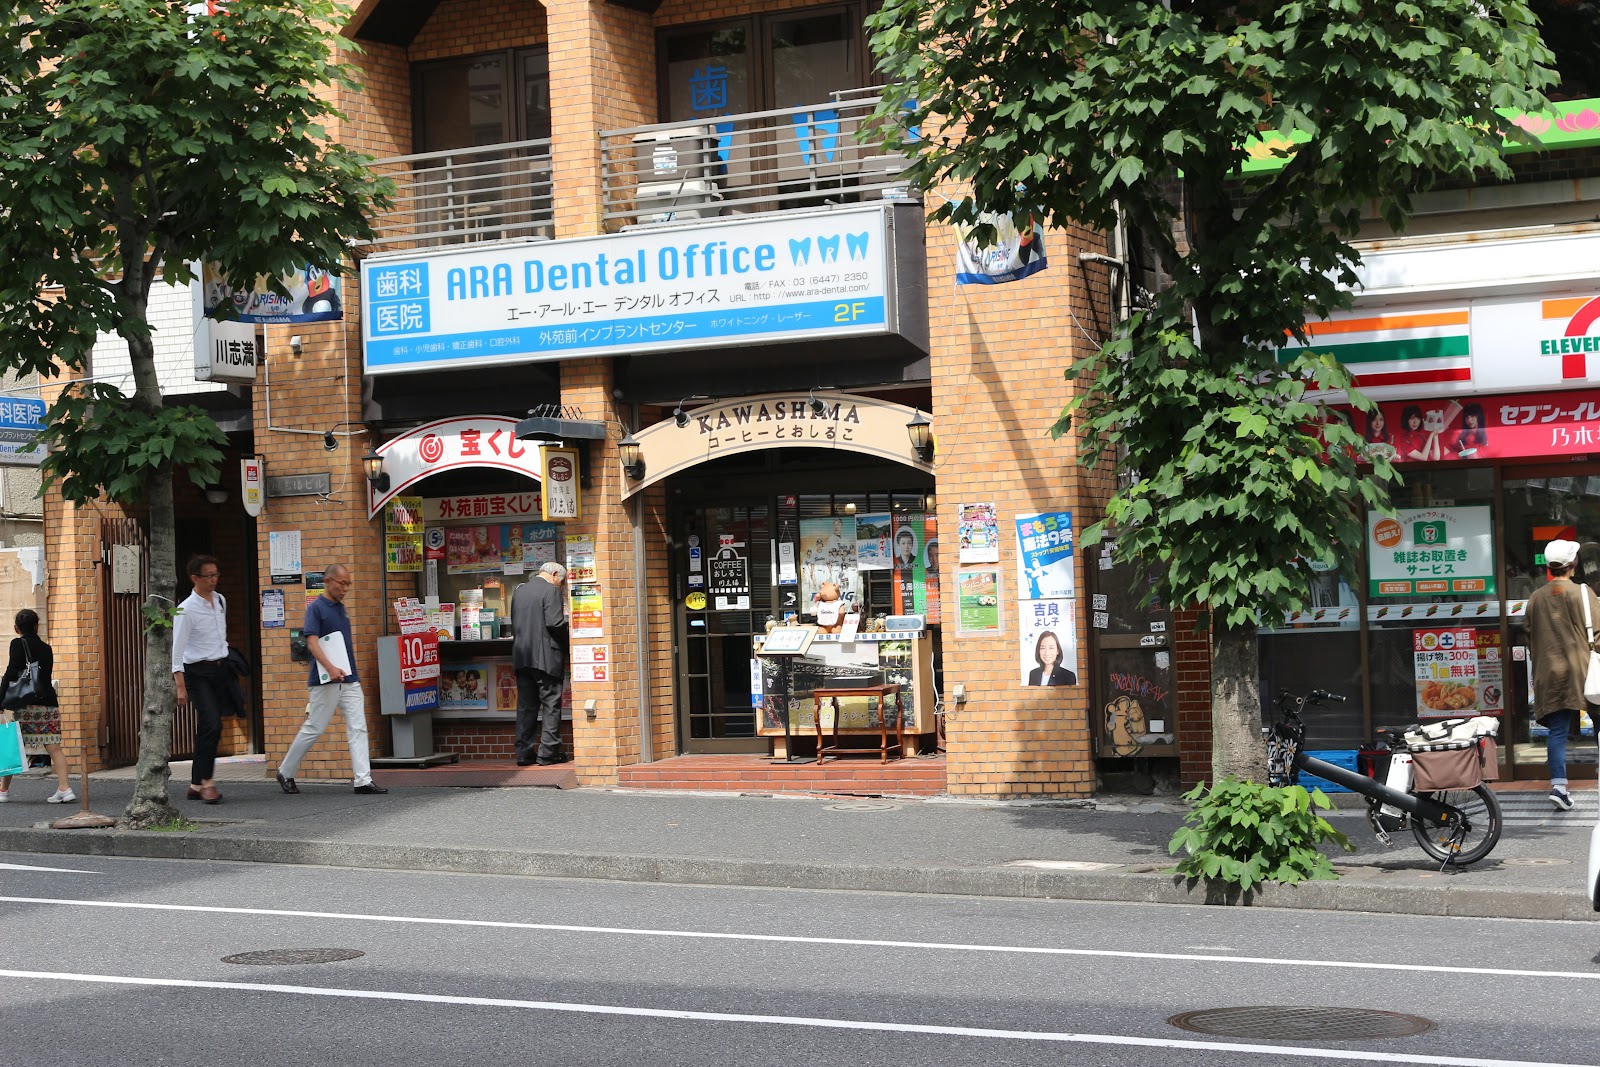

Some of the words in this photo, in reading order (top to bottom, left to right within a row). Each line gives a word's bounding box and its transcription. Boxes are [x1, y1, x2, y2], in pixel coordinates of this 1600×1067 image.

[688, 64, 729, 111] 歯
[447, 263, 513, 301] ARA
[523, 248, 646, 294] Dental
[658, 240, 775, 281] Office
[844, 271, 868, 282] 2350
[376, 267, 422, 298] 歯科
[507, 298, 607, 321] エー・アール・エー
[614, 292, 665, 313] デンタル
[669, 288, 721, 307] オフィス
[834, 301, 866, 323] 2F
[376, 302, 423, 332] 医院
[710, 312, 812, 329] ホワイトニング・レーザー
[538, 319, 697, 347] 外苑前インプラントセンター
[216, 339, 254, 367] 川志満
[0, 402, 41, 425] 科医院
[460, 427, 526, 459] 宝くじ
[708, 424, 854, 449] コーヒーとおしるこ
[552, 472, 569, 481] おしるこ
[1020, 513, 1070, 537] まもろう
[1022, 528, 1073, 553] 憲法9条
[713, 560, 742, 569] COFFEE
[1393, 549, 1468, 564] 雑誌お取置き
[713, 569, 742, 578] おしるこ
[1406, 563, 1455, 576] サービス
[1033, 602, 1060, 617] 吉良
[1034, 617, 1060, 627] よし子
[1423, 634, 1436, 647] 金
[1441, 634, 1453, 646] 土
[1455, 632, 1470, 640] 曜日
[404, 637, 424, 666] 10
[1450, 664, 1476, 678] 無料
